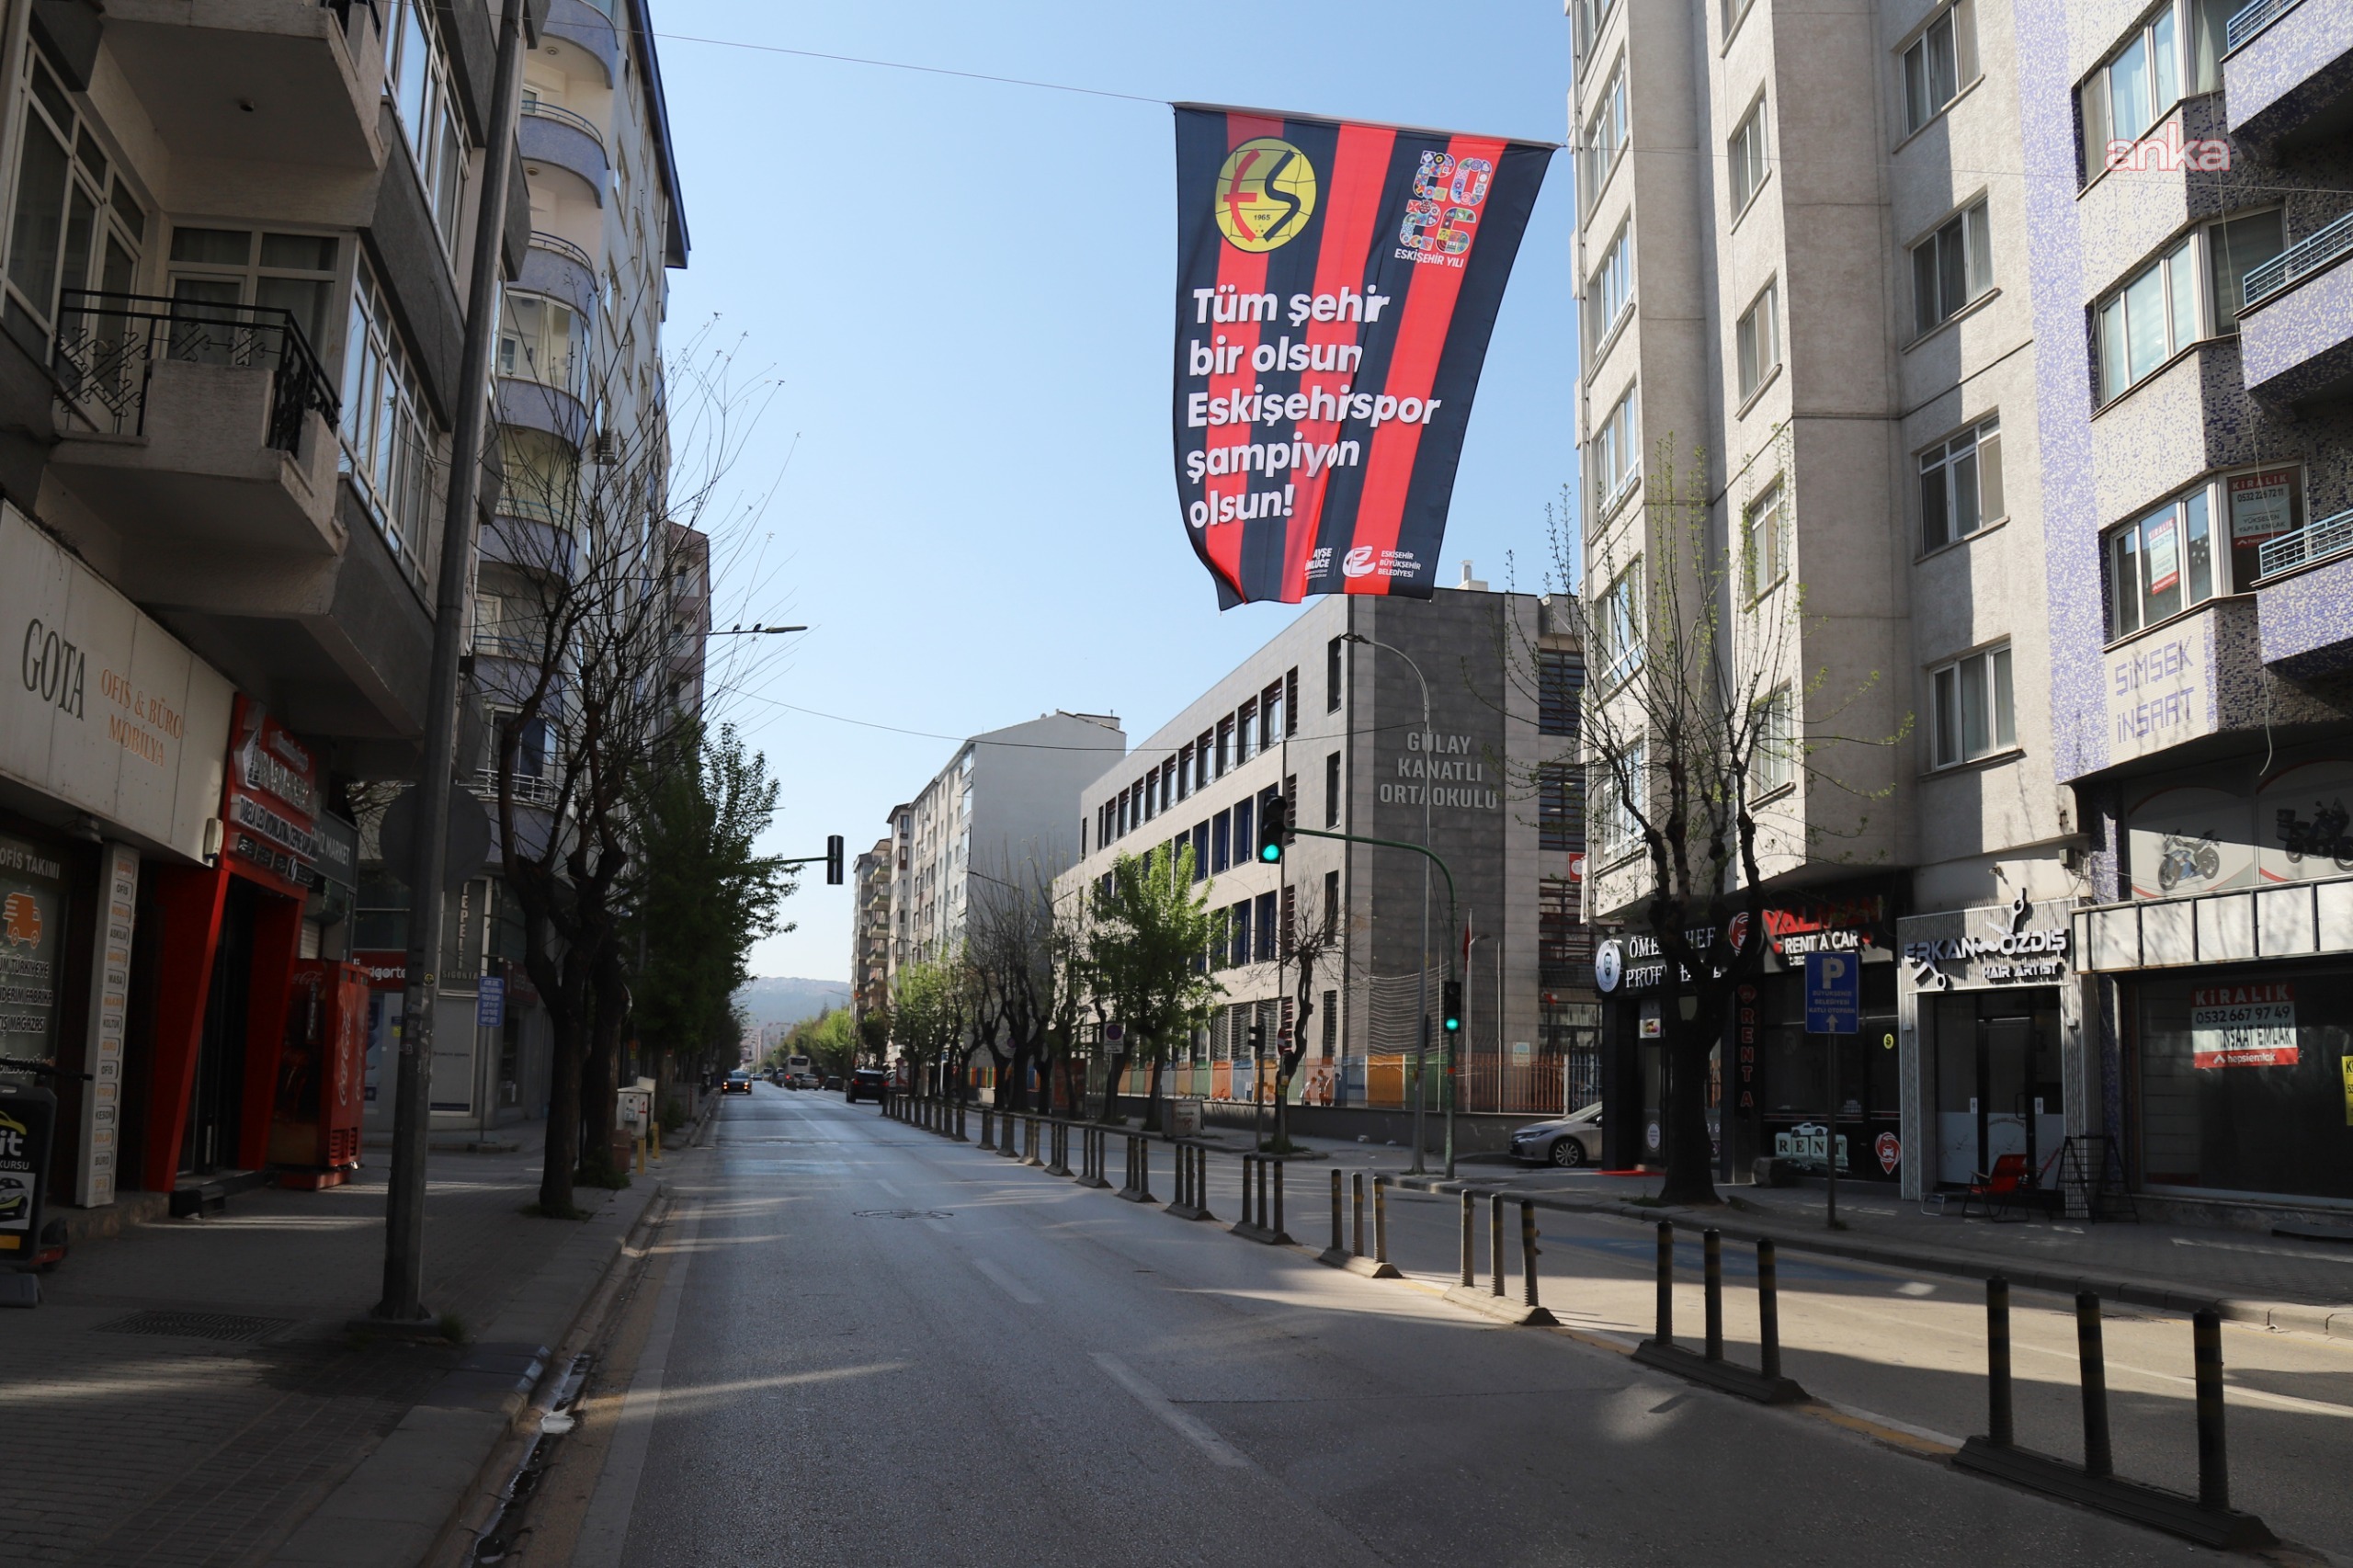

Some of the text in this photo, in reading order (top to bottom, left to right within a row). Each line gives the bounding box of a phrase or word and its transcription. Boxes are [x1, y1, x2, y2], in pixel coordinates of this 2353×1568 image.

[1394, 248, 1465, 268] ESKİŞEHİR YILI
[1193, 284, 1390, 327] Tüm şehir
[1189, 335, 1364, 376] bir olsun
[1188, 385, 1441, 427] Eskişehirspor
[1186, 432, 1359, 483] şampiyon
[1189, 484, 1295, 528] olsun!
[2237, 492, 2254, 503] 0532
[2268, 488, 2277, 497] 72
[2244, 514, 2279, 524] YÜKSELEN
[2261, 521, 2286, 530] EMLAK
[1313, 548, 1332, 560] AYŞE
[1379, 559, 1421, 571] BÜYÜKŞEHİR
[1381, 550, 1415, 560] ESKİŞEHİR
[1378, 568, 1414, 578] BELEDİYESİ
[2115, 635, 2193, 696] ŞİMŞEK
[22, 619, 182, 740] GOTA OFİS & BÜRO
[108, 713, 165, 767] MOBİLYA
[1407, 730, 1471, 754] GÜLAY
[1397, 758, 1482, 781] KANATLI
[1380, 783, 1497, 809] ORTAOKULU
[0, 846, 60, 880] OFİS TAKIMI
[116, 883, 129, 894] OFİS
[1784, 930, 1859, 955] RENT A CAR
[1904, 937, 1975, 962] ERKAN
[1822, 958, 1845, 989] P
[1982, 961, 2057, 979] HAIR ARTIST
[2195, 984, 2289, 1006] KİRALIK
[2196, 1006, 2290, 1024] 0532 667 97 49
[2256, 1022, 2292, 1046] EMLAK
[1739, 1007, 1755, 1108] RENT A
[2227, 1052, 2276, 1064] hepsiemlak
